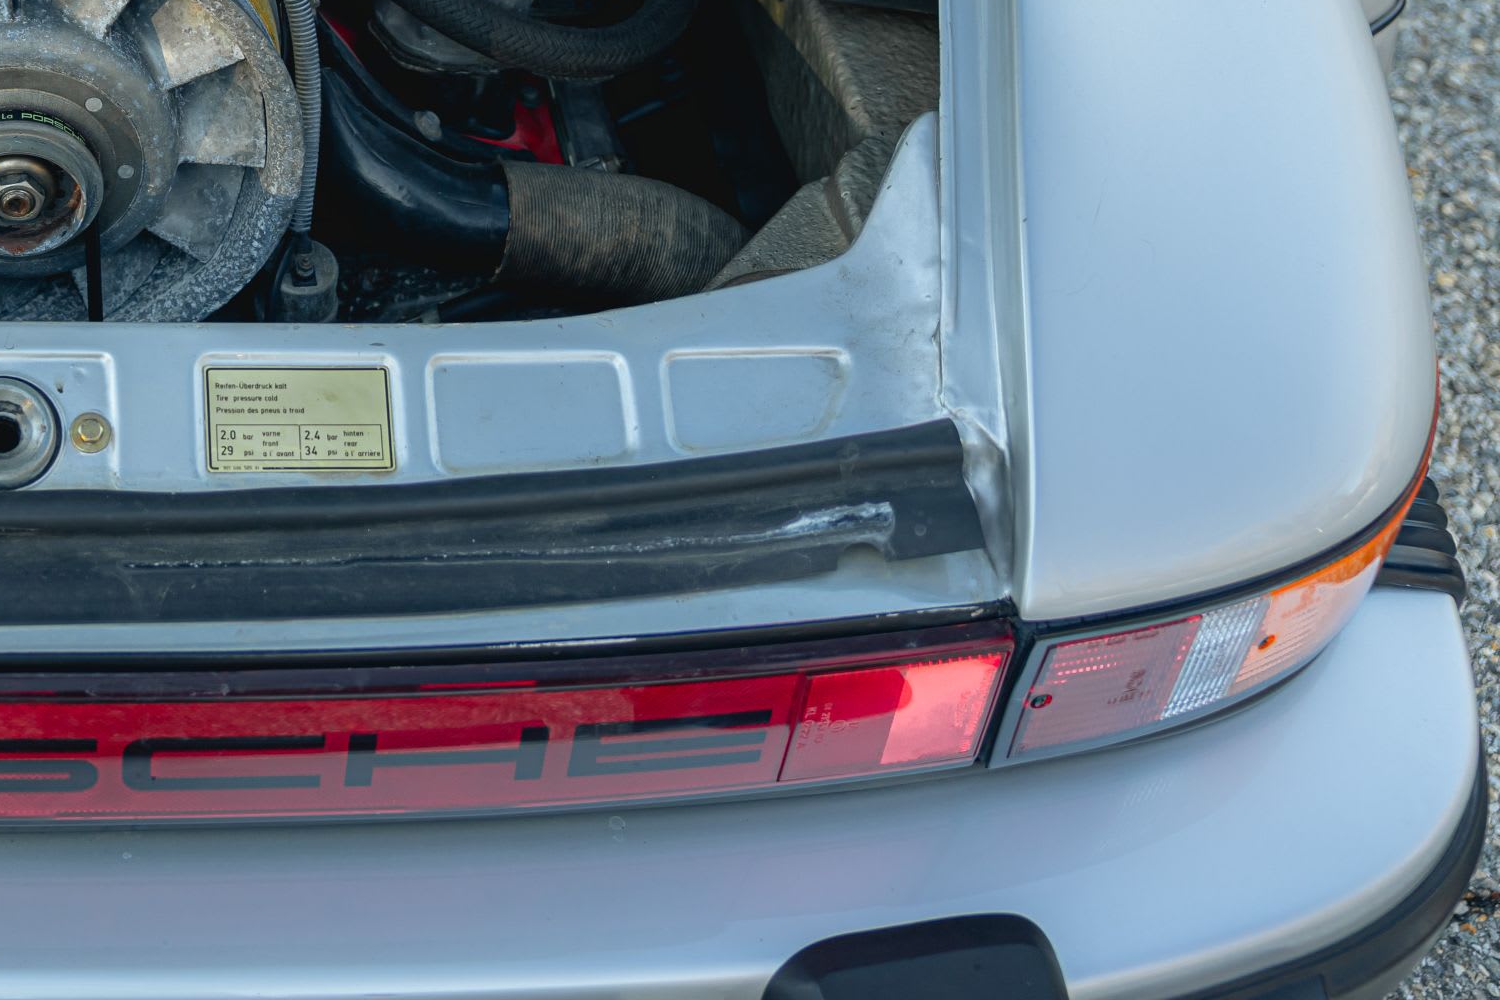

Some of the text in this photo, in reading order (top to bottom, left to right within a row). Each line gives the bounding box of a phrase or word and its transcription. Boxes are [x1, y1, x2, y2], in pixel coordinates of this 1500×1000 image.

[214, 381, 287, 390] Reifen-Überdruck kalt
[216, 394, 229, 402] Tire
[264, 394, 278, 402] cold
[326, 433, 338, 441] bar
[221, 445, 234, 456] 29
[305, 446, 318, 456] 34
[357, 449, 381, 457] arrière
